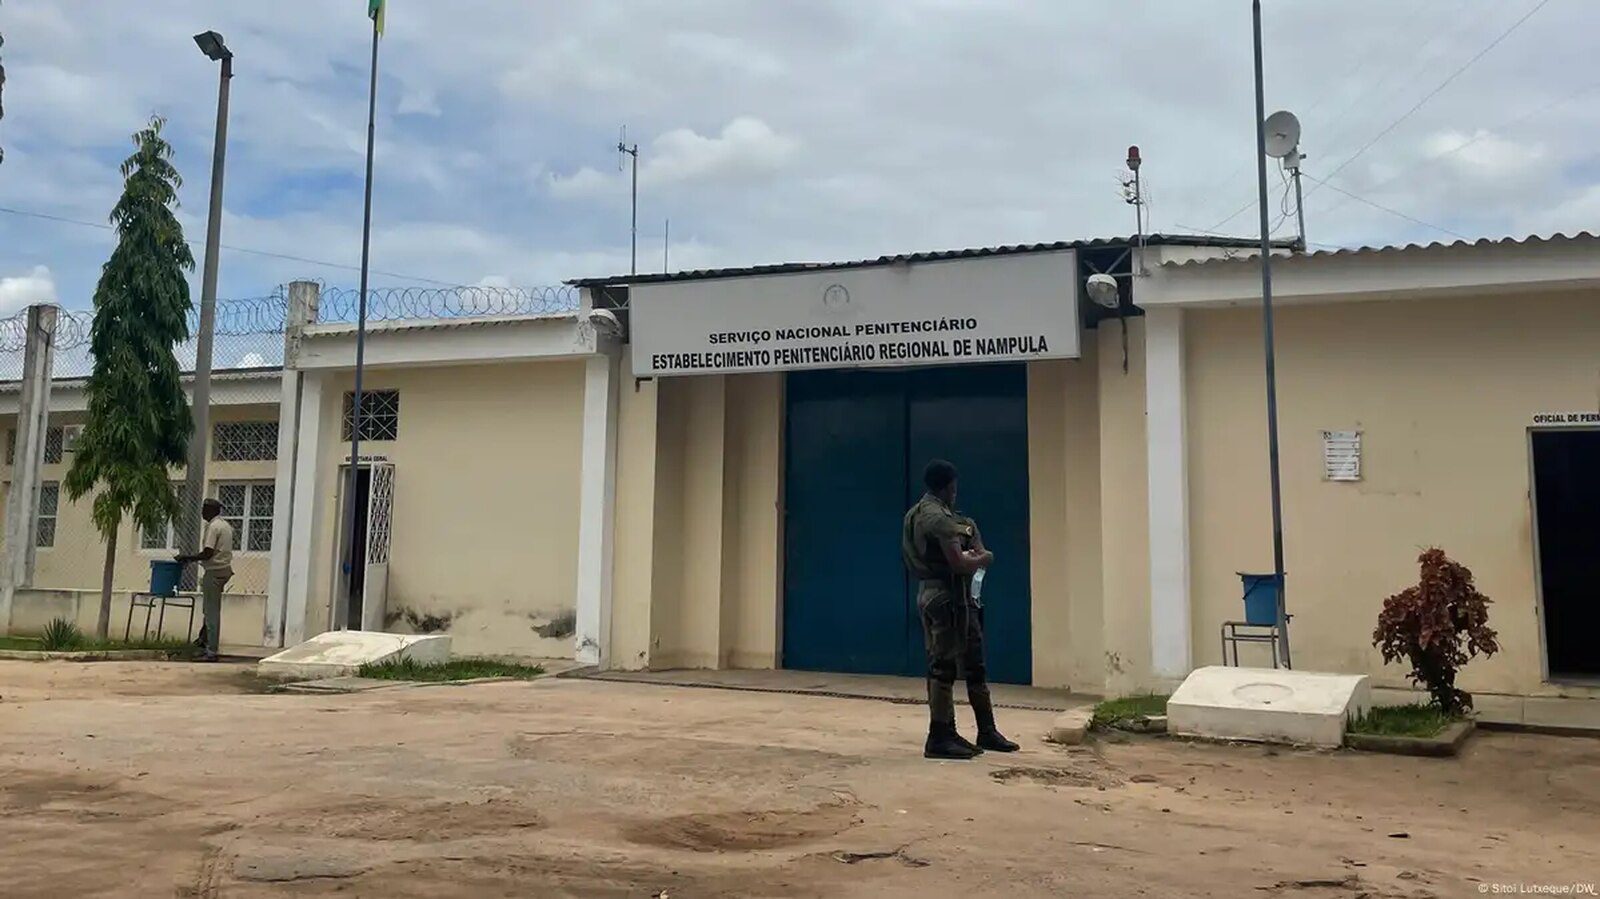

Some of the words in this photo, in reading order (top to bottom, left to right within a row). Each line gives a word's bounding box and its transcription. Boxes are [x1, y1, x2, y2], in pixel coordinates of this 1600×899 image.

[709, 330, 771, 345] SERVIÇO
[775, 325, 851, 341] NACIONAL
[855, 317, 978, 337] PENITENCIÁRIO
[652, 350, 771, 371] ESTABELECIMENTO
[773, 342, 875, 366] PENITENCIÁRIO
[879, 339, 949, 360] REGIONAL
[953, 339, 973, 357] DE
[976, 335, 1048, 356] NAMPULA
[1534, 414, 1566, 422] OFICIAL
[1567, 414, 1579, 422] DE
